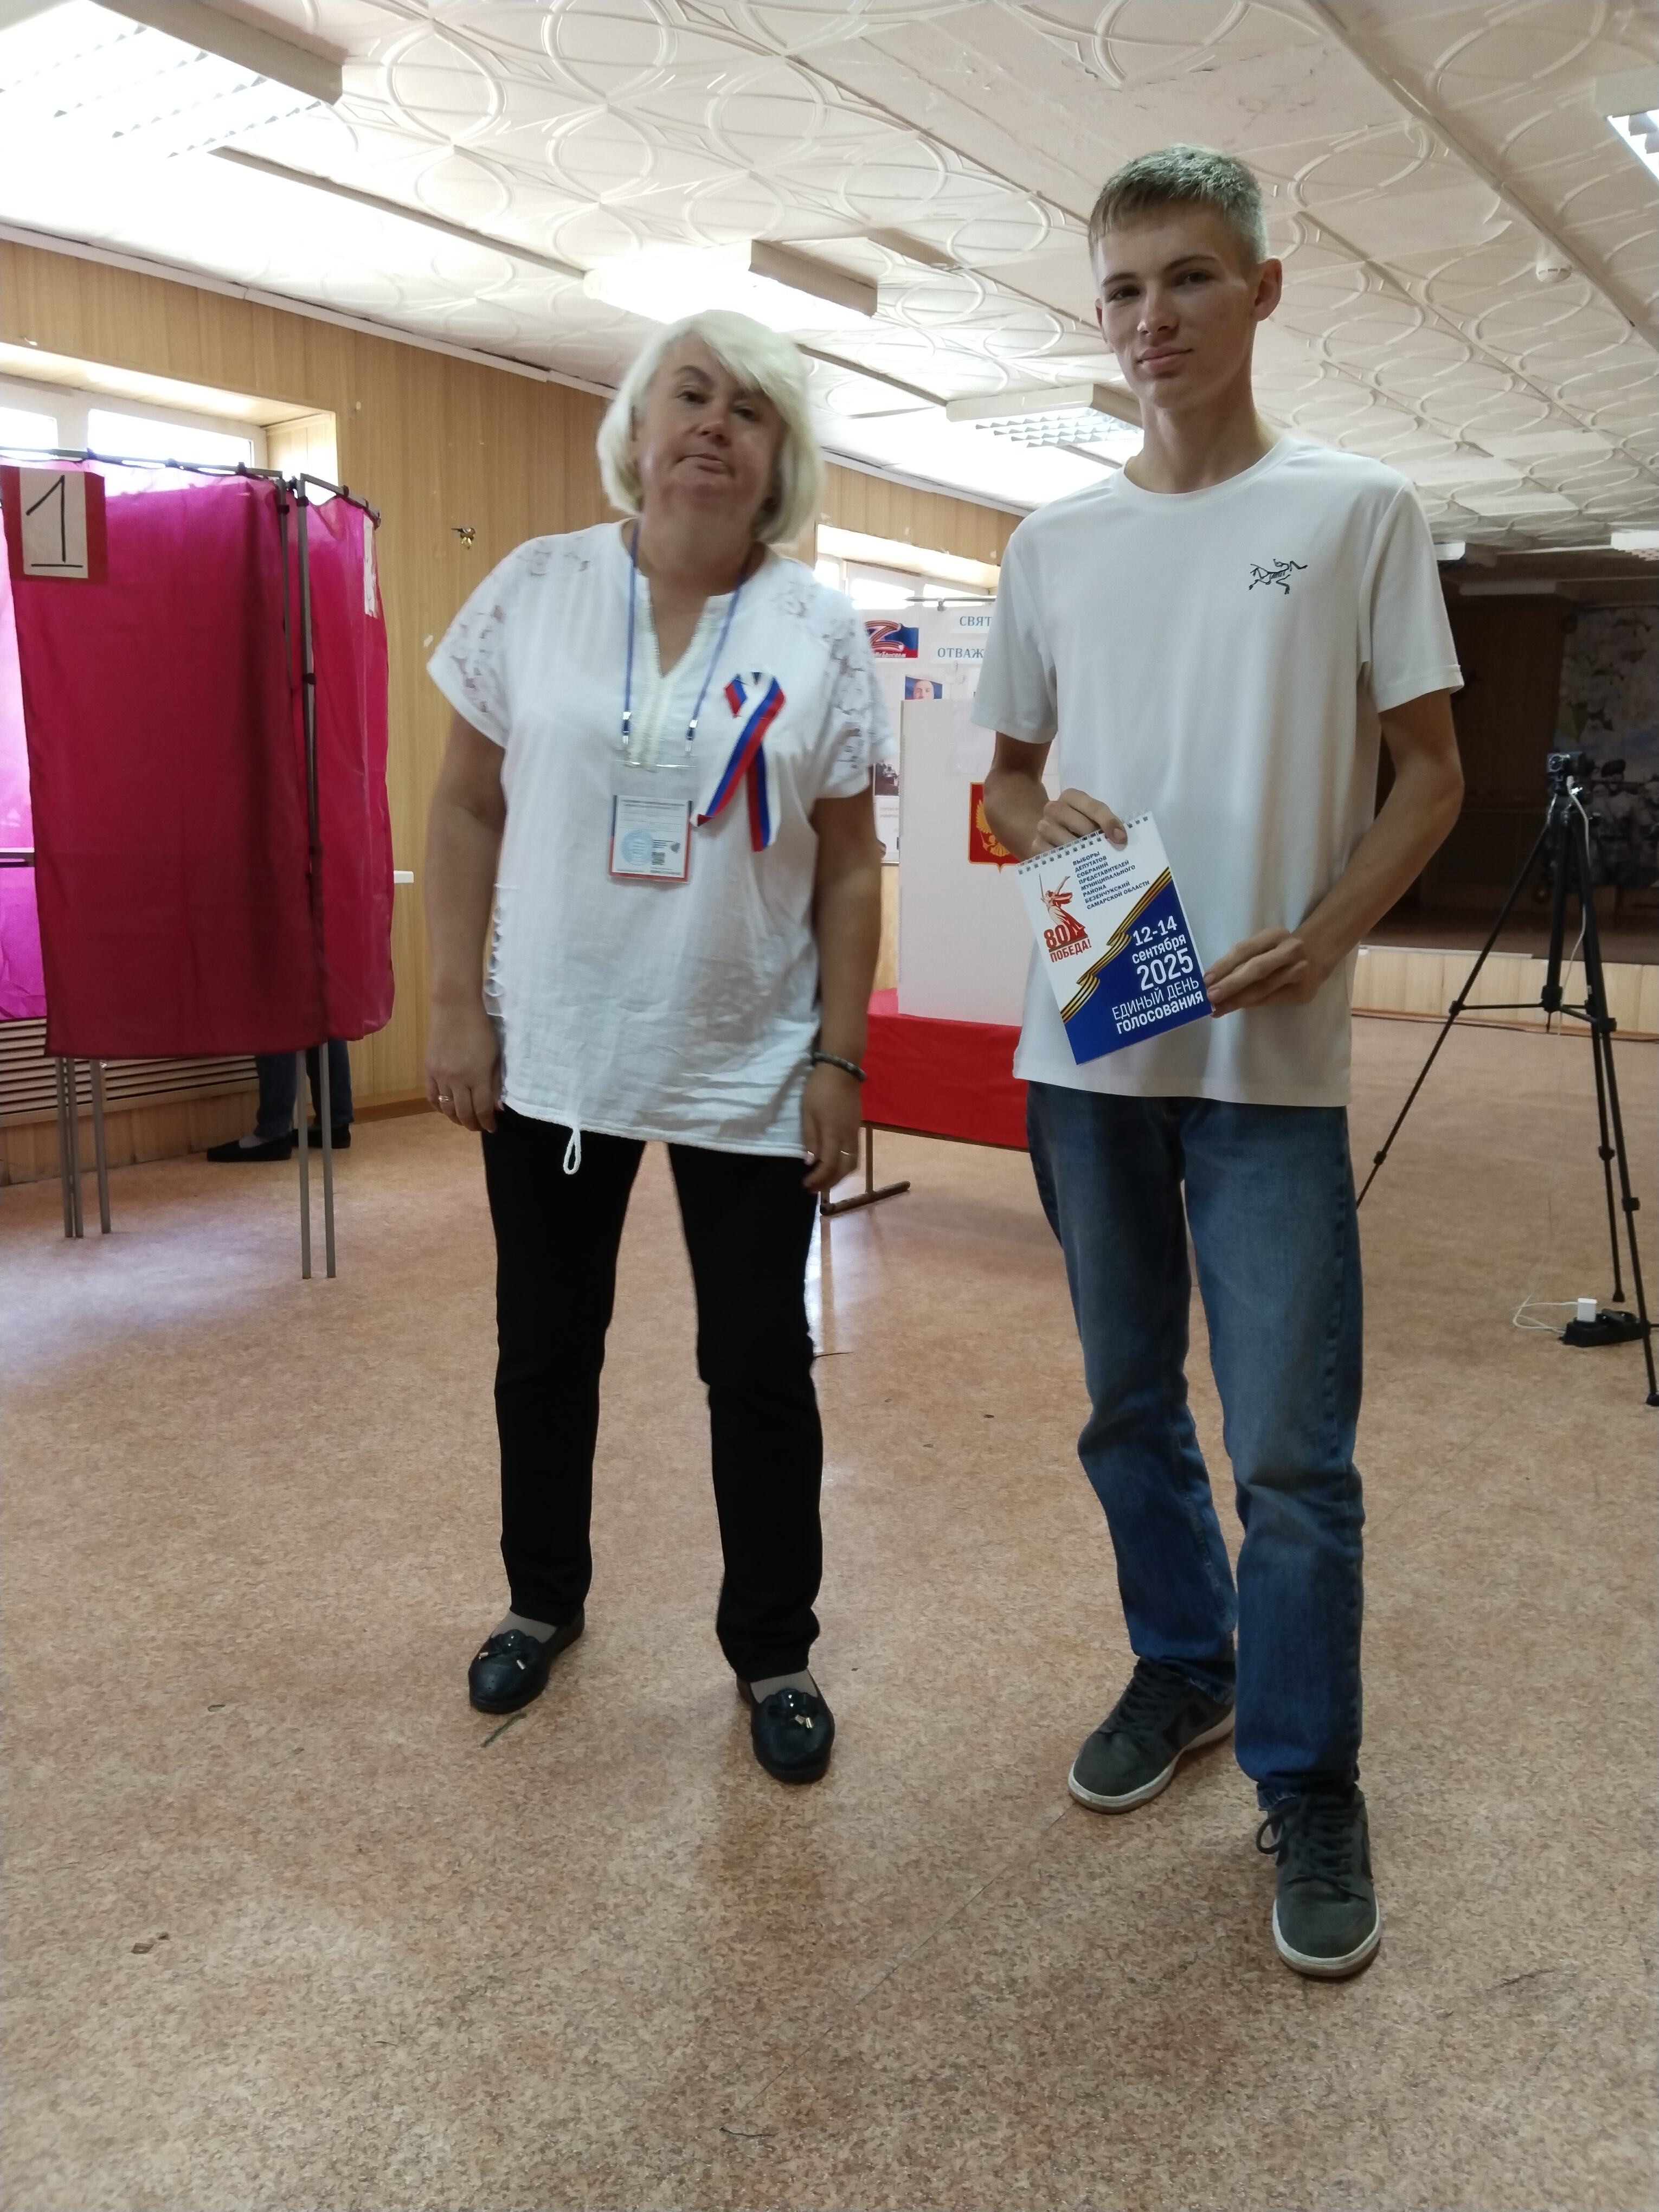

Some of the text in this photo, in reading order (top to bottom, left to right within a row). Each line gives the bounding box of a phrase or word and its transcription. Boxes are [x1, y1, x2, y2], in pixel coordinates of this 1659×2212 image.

[25, 474, 67, 563] 1
[959, 616, 993, 627] СВЯТ
[937, 647, 984, 658] ОТВАЖ
[1072, 851, 1100, 866] ВЫБОРЫ
[1075, 856, 1107, 873] ДЕПУТАТОВ
[1077, 861, 1109, 878] СОБРАНИЙ
[1078, 859, 1129, 885] ПРЕДСТАВИТЕЛЕЙ
[1081, 865, 1136, 891] МУНИЦИПАЛЬНОГО
[1083, 884, 1107, 897] РАЙОНА
[1086, 880, 1150, 910] САМАРСКОЙ ОБЛАСТИ
[1044, 924, 1069, 949] 80
[1133, 915, 1178, 946] 12-14
[1050, 938, 1092, 963] ПОБЕДА!
[1132, 934, 1186, 964] сентября
[1136, 947, 1193, 991] 2025
[1111, 977, 1199, 1020] ЕДИНЫЙ ДЕНЬ
[1116, 991, 1204, 1034] голосования
